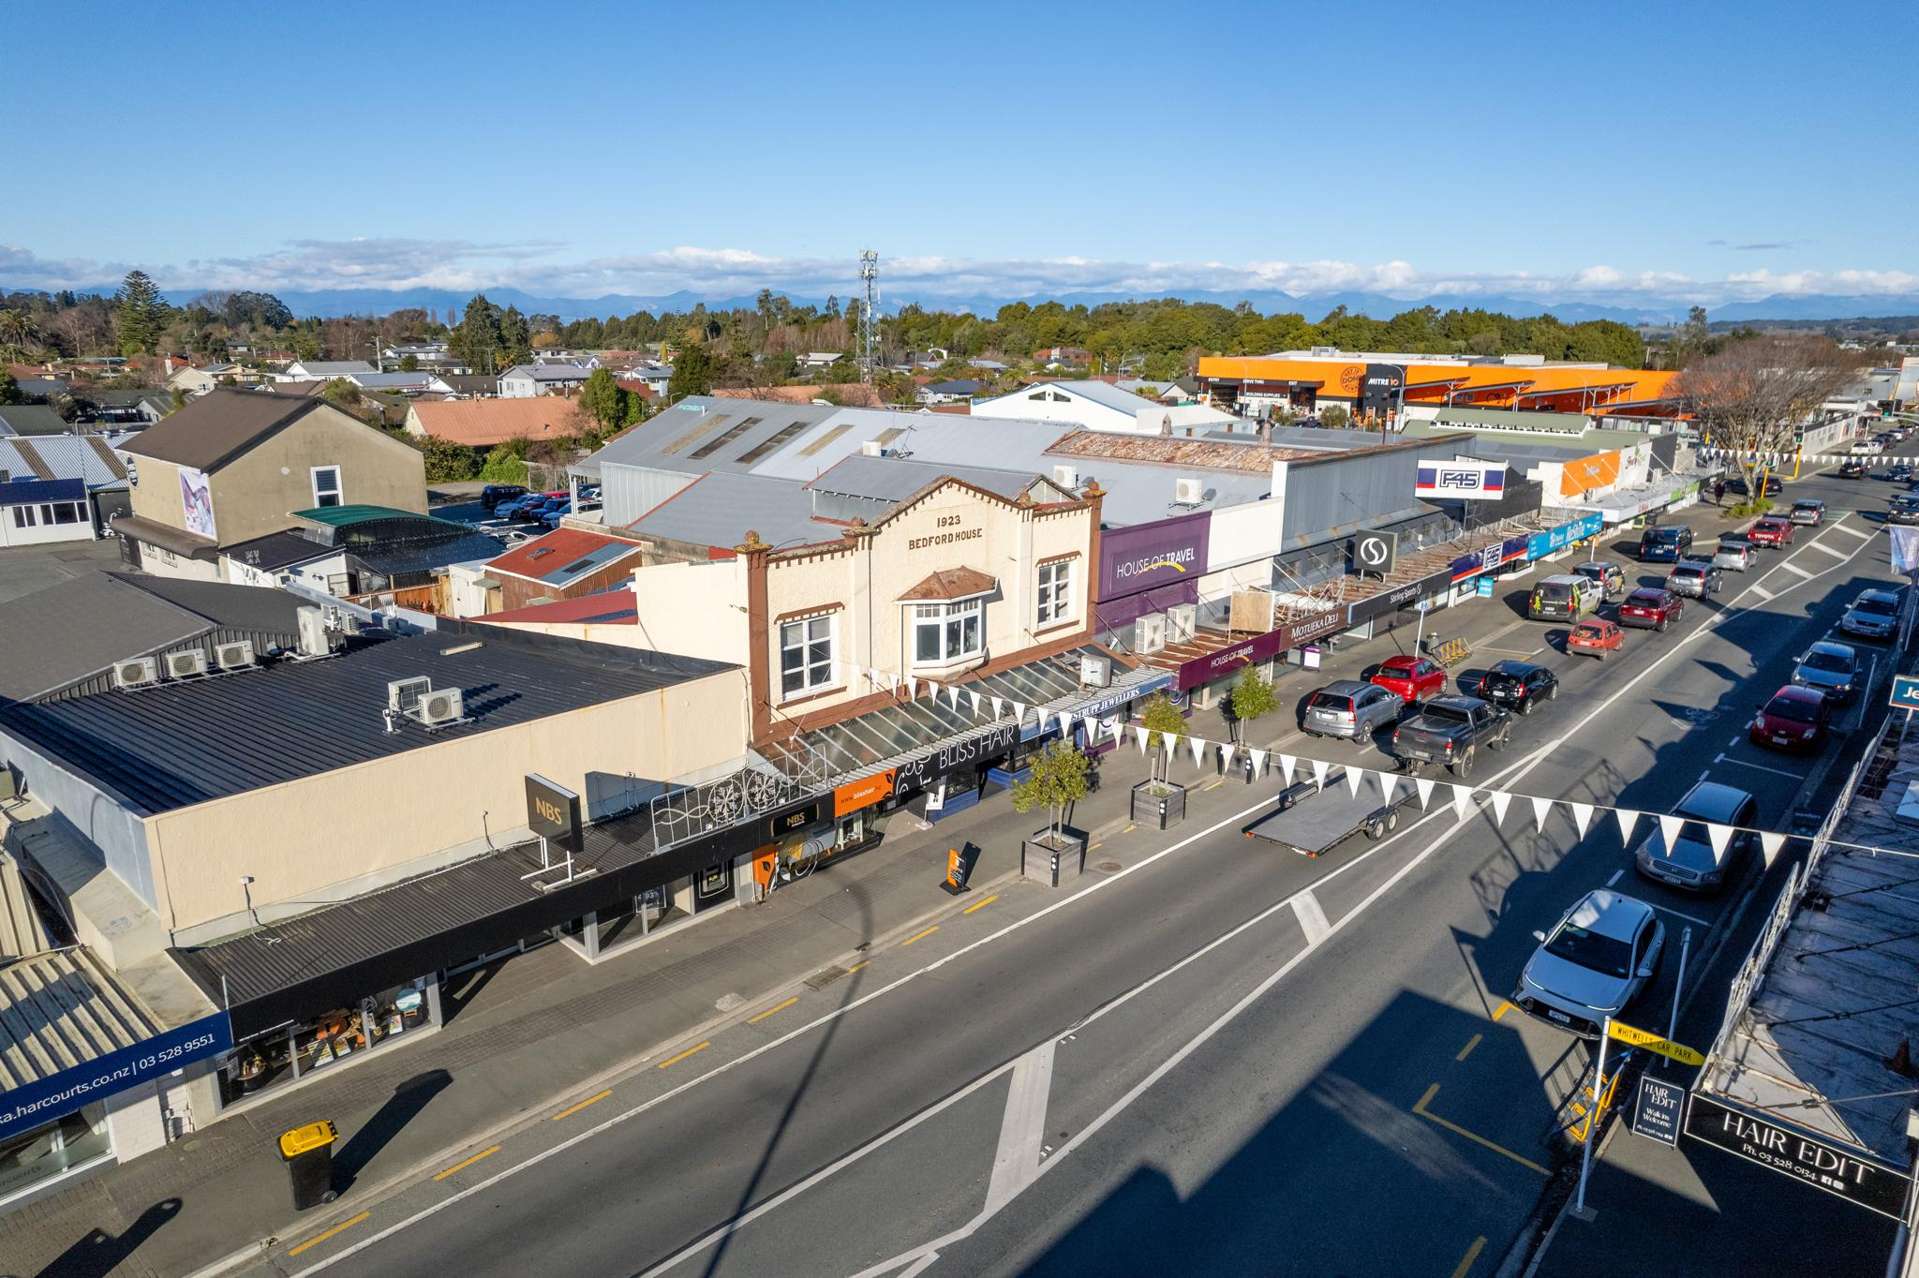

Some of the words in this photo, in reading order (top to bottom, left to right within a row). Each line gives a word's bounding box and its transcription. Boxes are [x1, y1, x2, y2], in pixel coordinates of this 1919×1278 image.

[1368, 377, 1390, 386] MITRE
[1441, 471, 1479, 488] F45
[936, 514, 961, 528] 1923
[908, 534, 954, 551] BEDFORD
[954, 528, 983, 543] HOUSE
[1116, 558, 1150, 578] HOUSE
[1151, 554, 1166, 571] OF
[1166, 547, 1196, 567] TRAVEL
[1291, 620, 1325, 640] MOTUEKA
[1324, 612, 1339, 627] DELI
[1100, 688, 1141, 711] JEWELLERS
[939, 738, 975, 770] BLISS
[980, 723, 1015, 755] HAIR
[535, 797, 562, 825] NBS
[786, 811, 805, 827] NBS
[139, 1054, 157, 1071] 03
[158, 1046, 183, 1064] 528
[184, 1033, 215, 1052] 9551
[1673, 1046, 1692, 1059] PARK
[1644, 1083, 1669, 1098] HAIR
[1651, 1094, 1677, 1109] EDIT
[1723, 1111, 1787, 1154] HAIR
[1799, 1141, 1876, 1184] EDIT
[1743, 1143, 1757, 1157] Ph.
[1759, 1151, 1773, 1164] 03
[1773, 1156, 1793, 1170] 528
